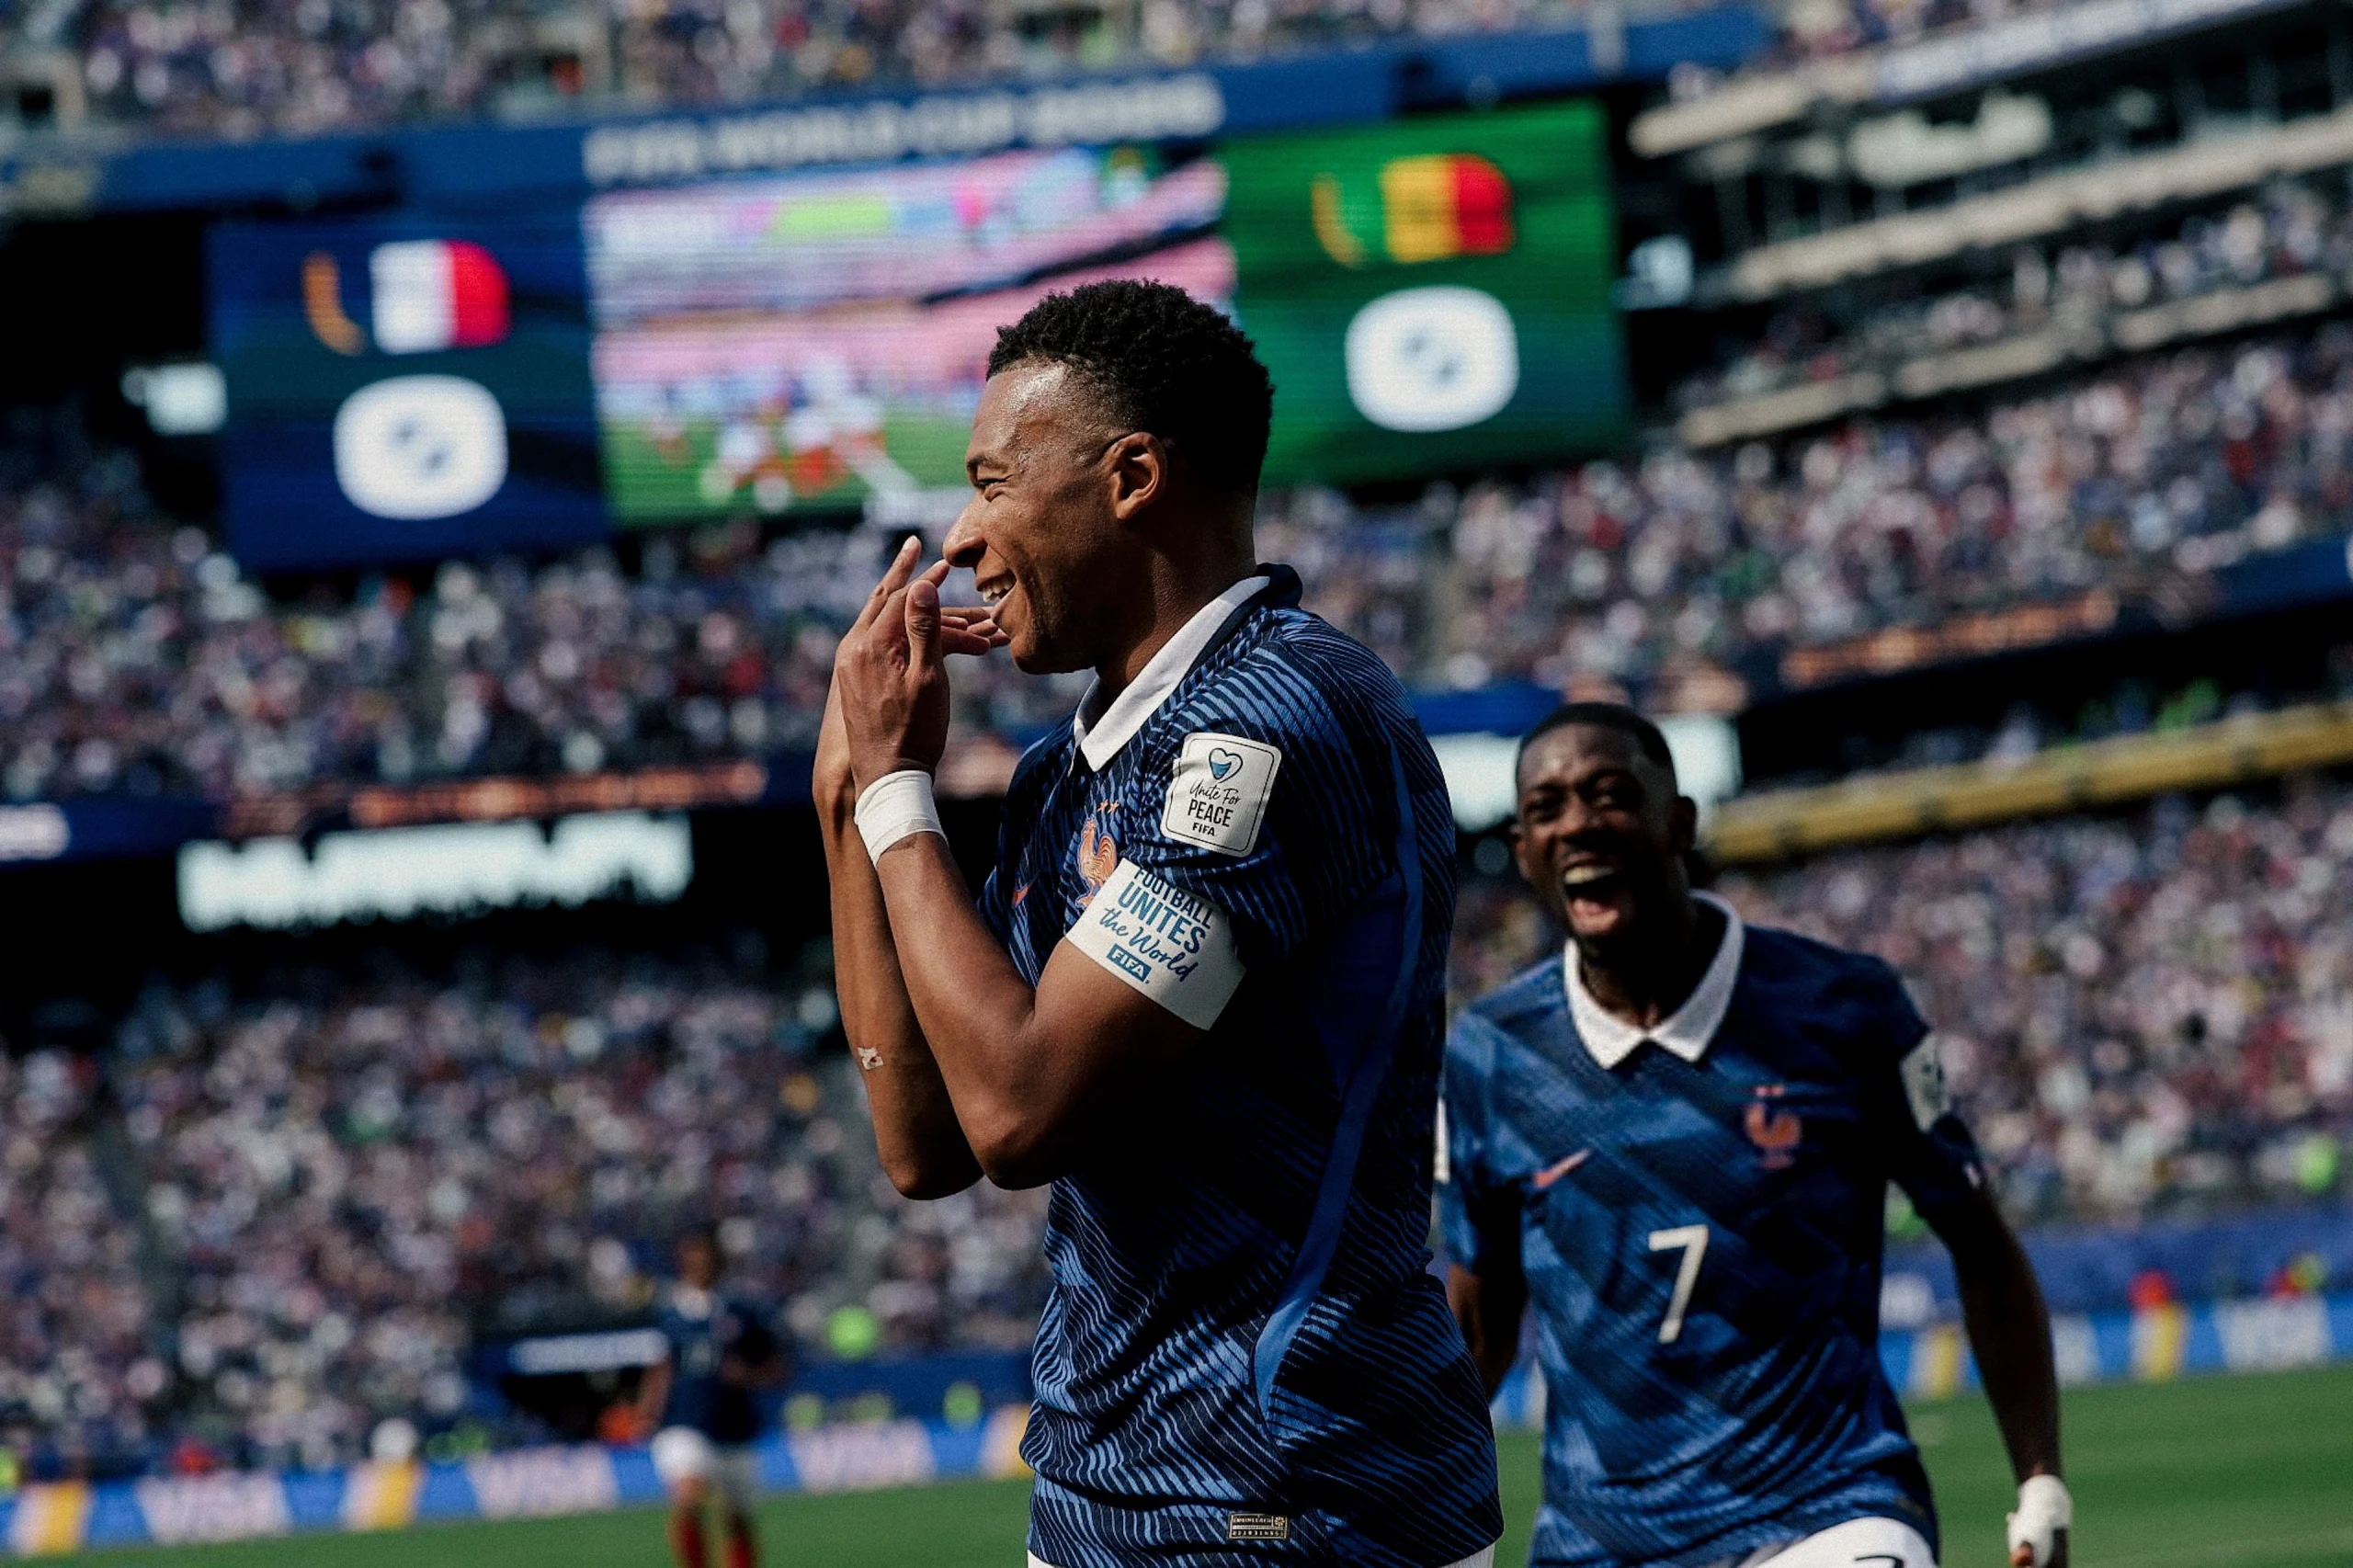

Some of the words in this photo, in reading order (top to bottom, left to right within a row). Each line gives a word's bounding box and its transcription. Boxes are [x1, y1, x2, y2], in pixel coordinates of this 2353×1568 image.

[1188, 799, 1233, 827] PEACE
[1189, 779, 1222, 801] Unite
[1222, 788, 1242, 805] For
[1192, 822, 1216, 836] FIFA
[1117, 881, 1207, 955] UNITES
[1132, 867, 1215, 930] FOOTBALL
[1099, 907, 1130, 937] the
[1129, 926, 1199, 983] World
[1110, 949, 1145, 978] FIFA
[1648, 1223, 1710, 1344] 7
